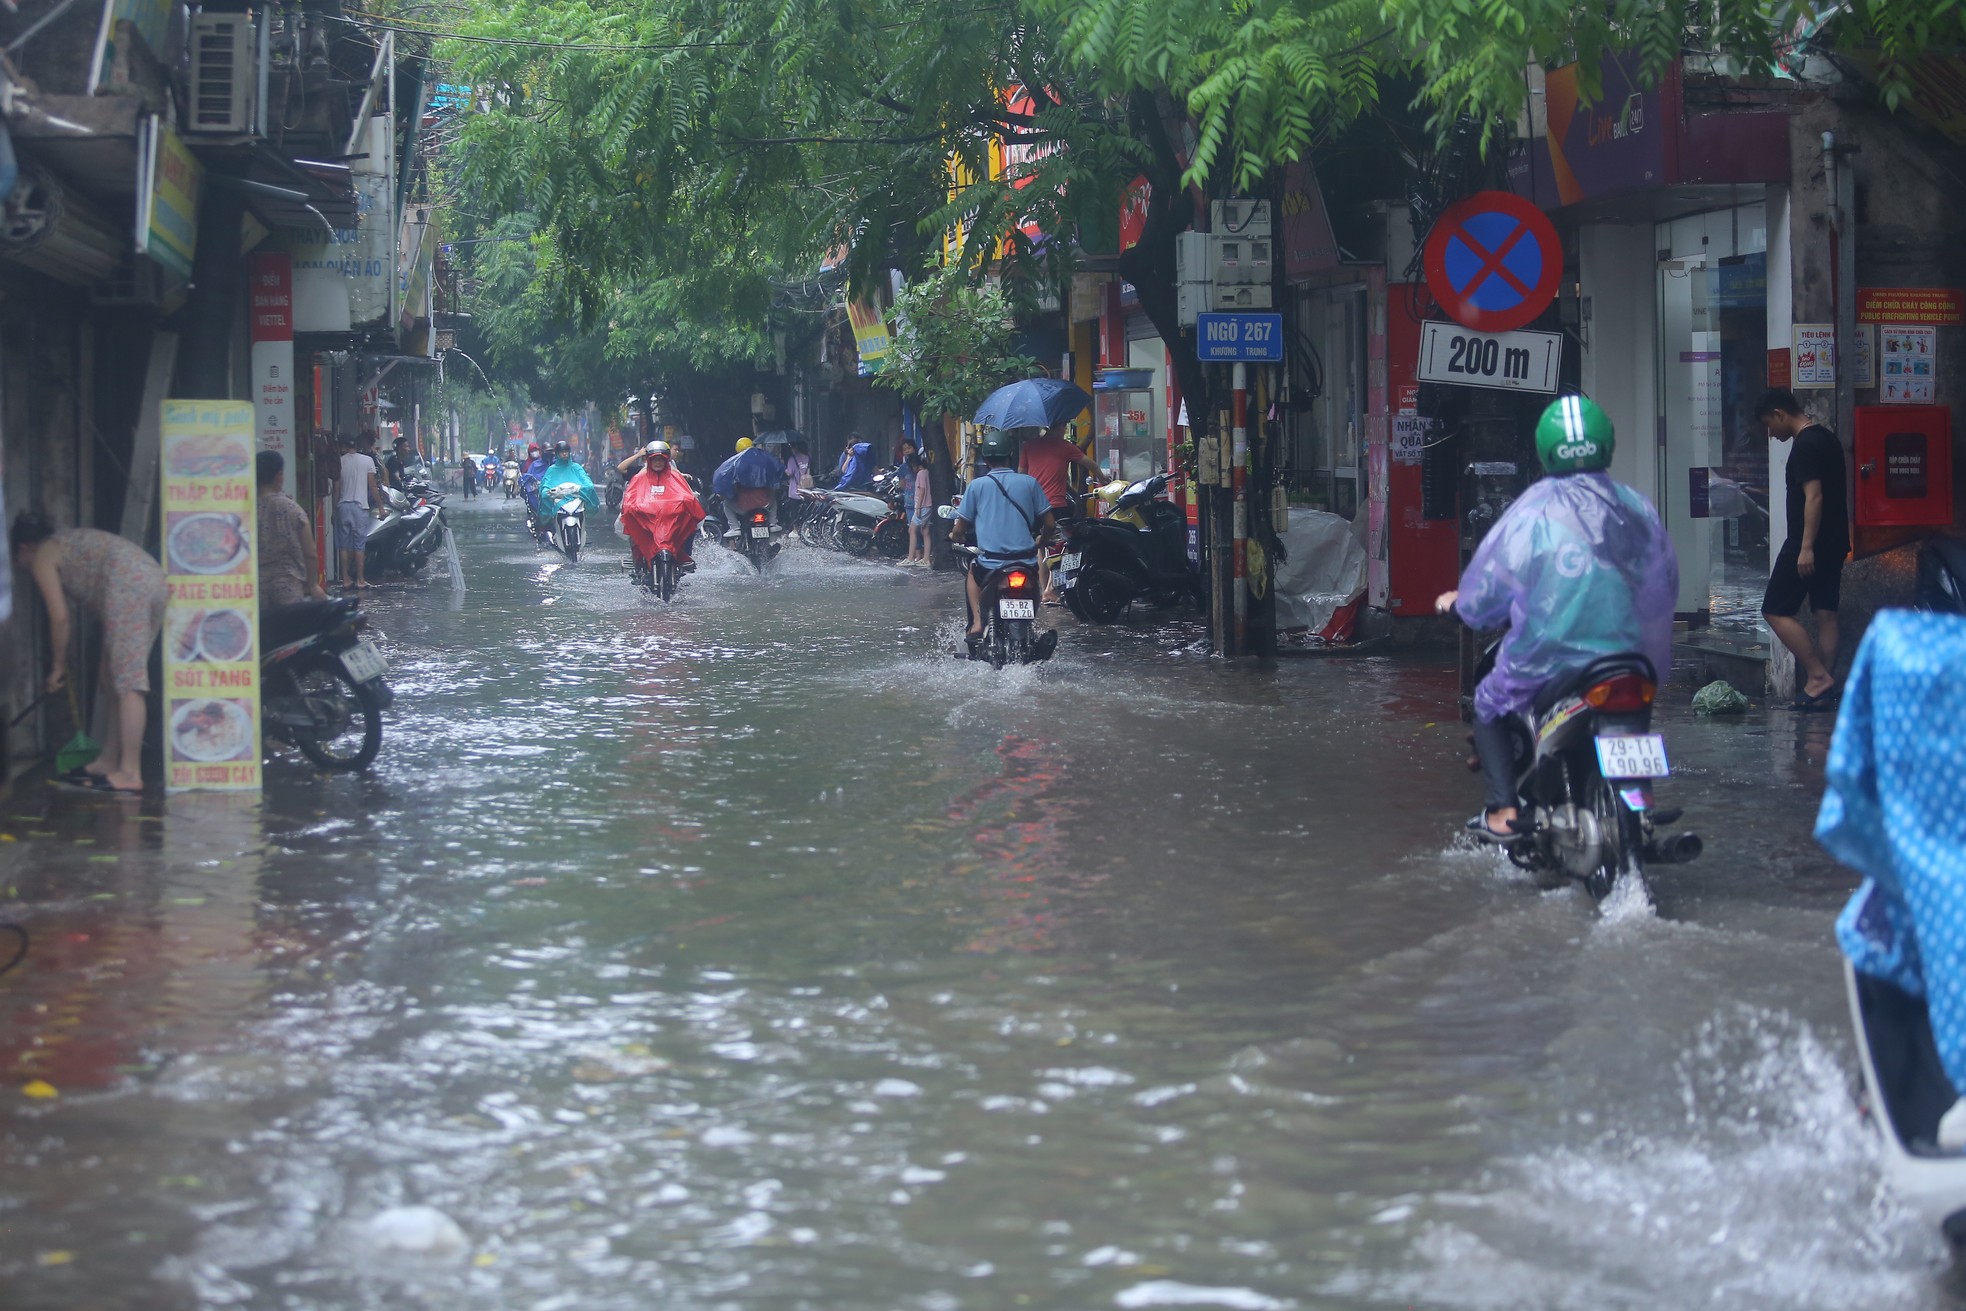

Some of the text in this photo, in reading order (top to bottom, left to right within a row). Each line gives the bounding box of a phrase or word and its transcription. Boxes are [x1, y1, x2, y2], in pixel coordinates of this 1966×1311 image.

[1902, 301, 1918, 309] CHÁY
[258, 313, 287, 327] VIETTEL
[1860, 312, 1881, 320] PUBLIC
[1882, 312, 1919, 321] FIREFIGHTING
[1207, 318, 1273, 342] NGÕ 267
[1245, 346, 1268, 356] TRUNG
[1448, 335, 1530, 379] 200 m
[1127, 410, 1146, 422] 35k
[1557, 440, 1597, 459] Grab
[167, 482, 208, 503] THẬP
[167, 583, 206, 600] PATE
[174, 664, 252, 688] SỐT VANG
[1608, 738, 1653, 756] 29-T1
[1608, 756, 1663, 776] 490.96
